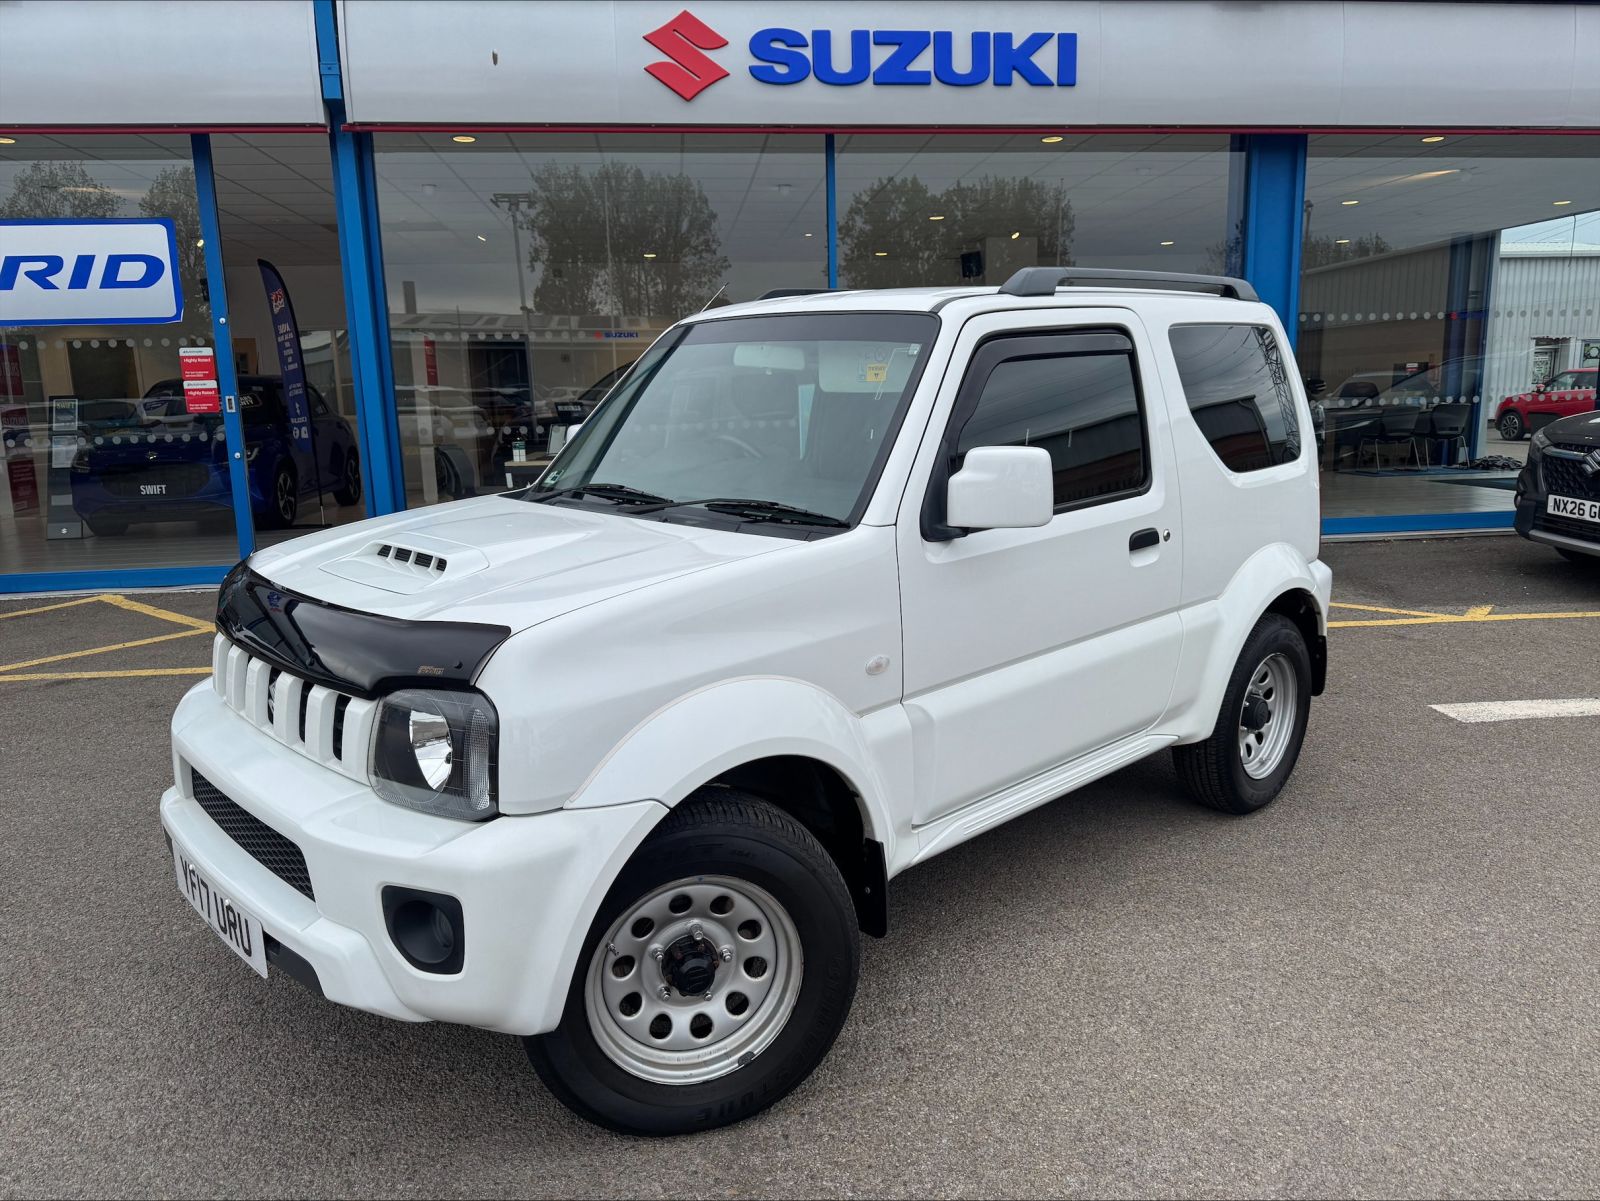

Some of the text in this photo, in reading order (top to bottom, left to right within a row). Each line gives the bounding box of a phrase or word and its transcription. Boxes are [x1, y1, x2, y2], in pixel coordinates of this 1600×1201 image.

[748, 27, 1078, 88] SUZUKI
[0, 254, 165, 290] RID
[140, 484, 167, 495] SWIFT
[1553, 497, 1600, 520] NX26 G
[179, 854, 252, 957] YF17 URU
